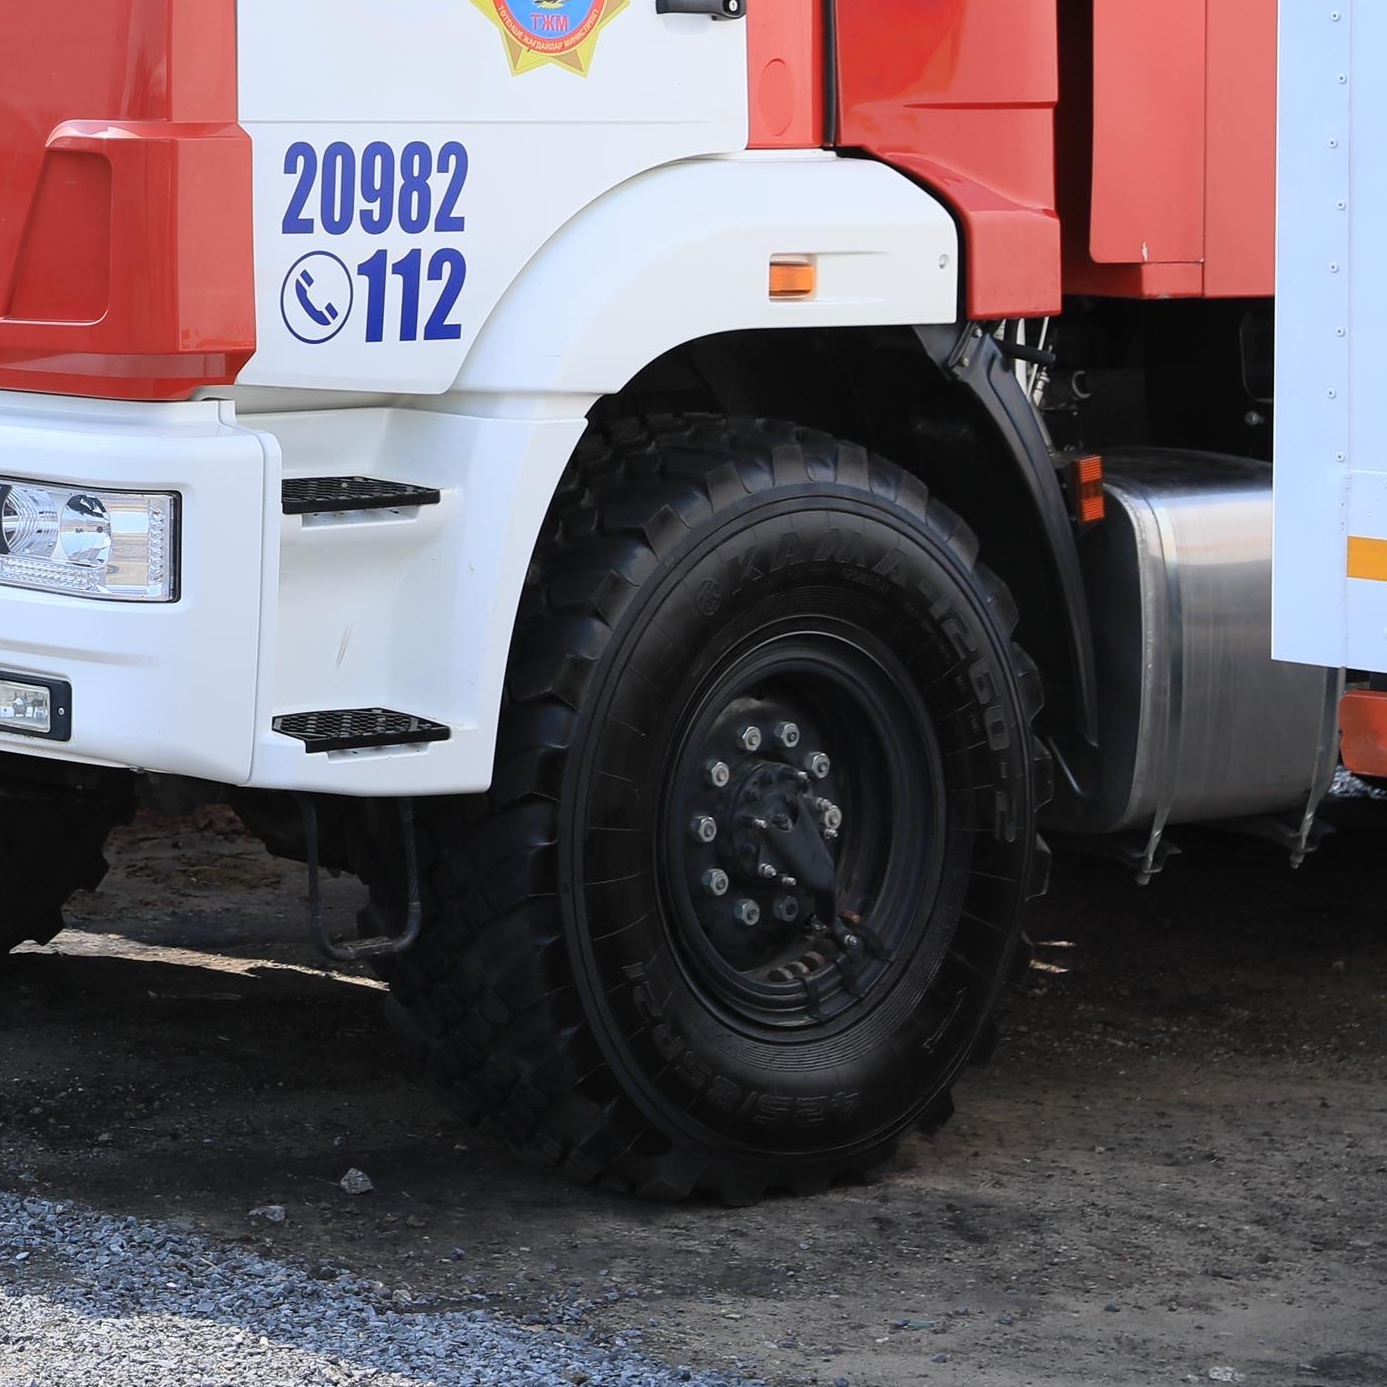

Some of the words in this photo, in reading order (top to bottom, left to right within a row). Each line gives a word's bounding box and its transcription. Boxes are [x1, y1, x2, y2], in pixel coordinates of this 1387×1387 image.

[531, 13, 568, 31] ТЖМ
[281, 141, 469, 235] 20982
[356, 247, 467, 342] 112
